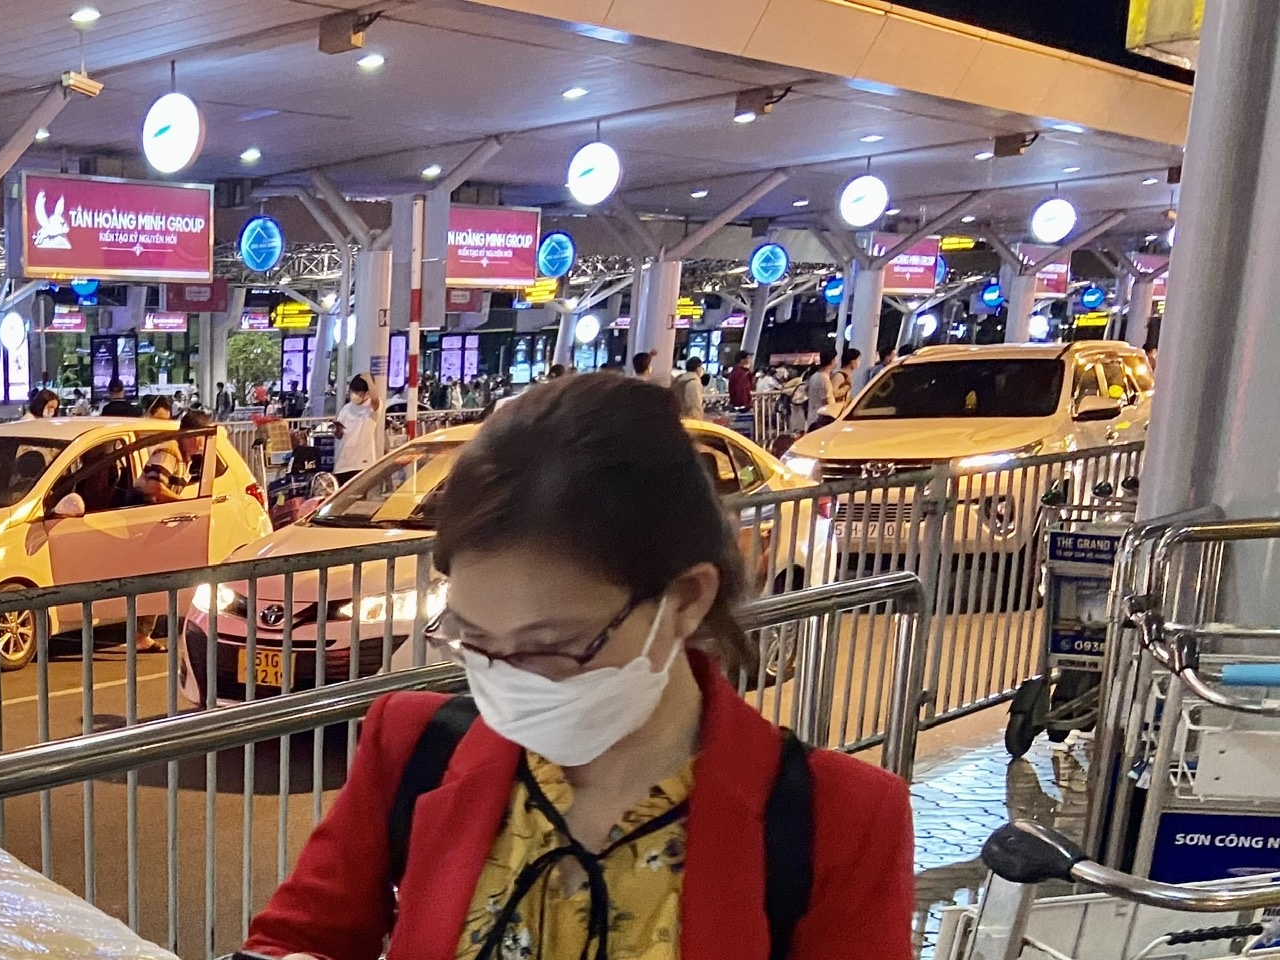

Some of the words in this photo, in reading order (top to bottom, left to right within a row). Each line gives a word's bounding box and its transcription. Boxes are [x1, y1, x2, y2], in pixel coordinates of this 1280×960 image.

[69, 205, 93, 228] TÂN
[94, 208, 137, 230] HOÀNG
[138, 213, 166, 232] MINH
[167, 215, 205, 233] GROUP
[506, 233, 534, 249] GROUP
[1056, 536, 1075, 549] THE
[1077, 538, 1111, 551] GRAND
[1174, 833, 1212, 846] SƠN
[1214, 833, 1265, 849] CÔNG
